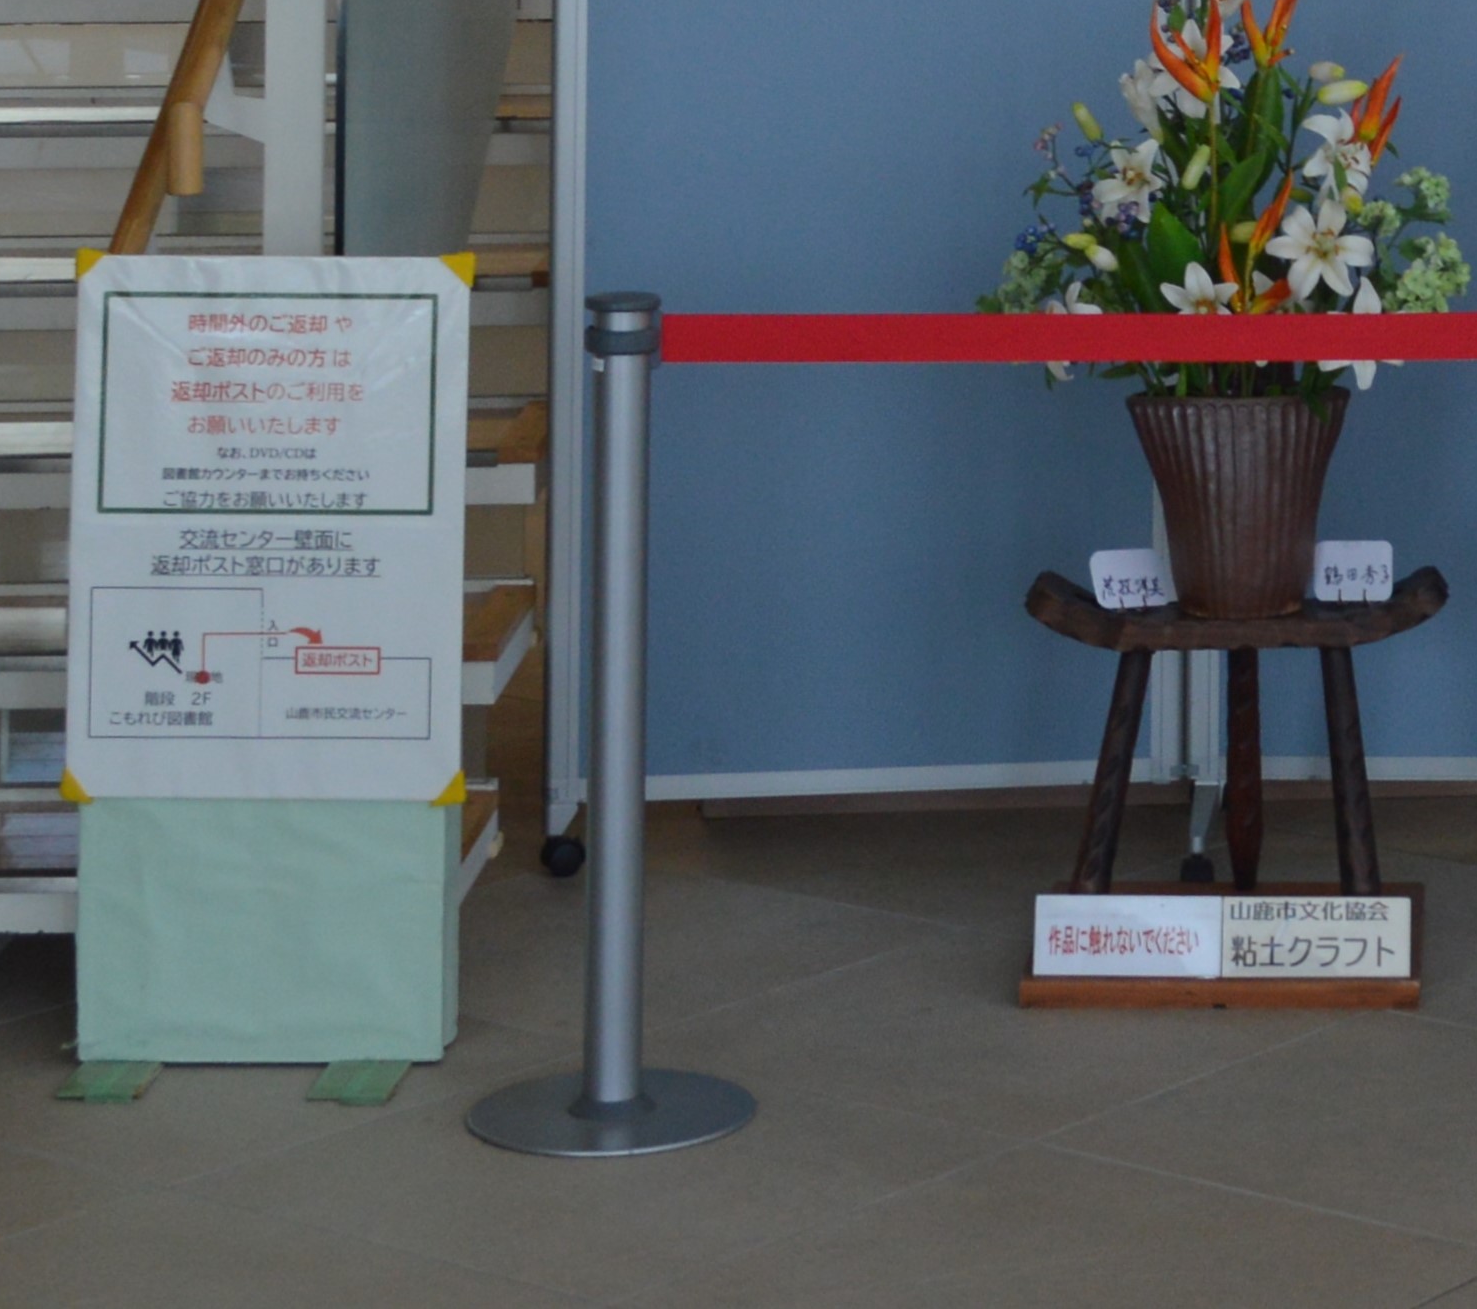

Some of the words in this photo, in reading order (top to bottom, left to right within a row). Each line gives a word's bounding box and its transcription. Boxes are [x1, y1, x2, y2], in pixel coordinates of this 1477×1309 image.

[171, 381, 364, 402] 返却ポストのご利用を
[187, 415, 341, 435] お願いいたします
[162, 467, 371, 481] 図書館カウンターまでお持ちください
[163, 490, 368, 509] ご協力をお願いいたします
[179, 529, 353, 550] 交流センター壁面に
[151, 554, 381, 576] 返却ポスト窓口があります
[302, 652, 373, 668] 返却ポスト
[191, 692, 212, 706] 2F
[109, 710, 214, 727] こもれび図書館
[1229, 900, 1390, 923] 山鹿市文化協会
[1048, 925, 1201, 957] 作品に触れないでください
[1230, 935, 1396, 968] 粘土クラフト
